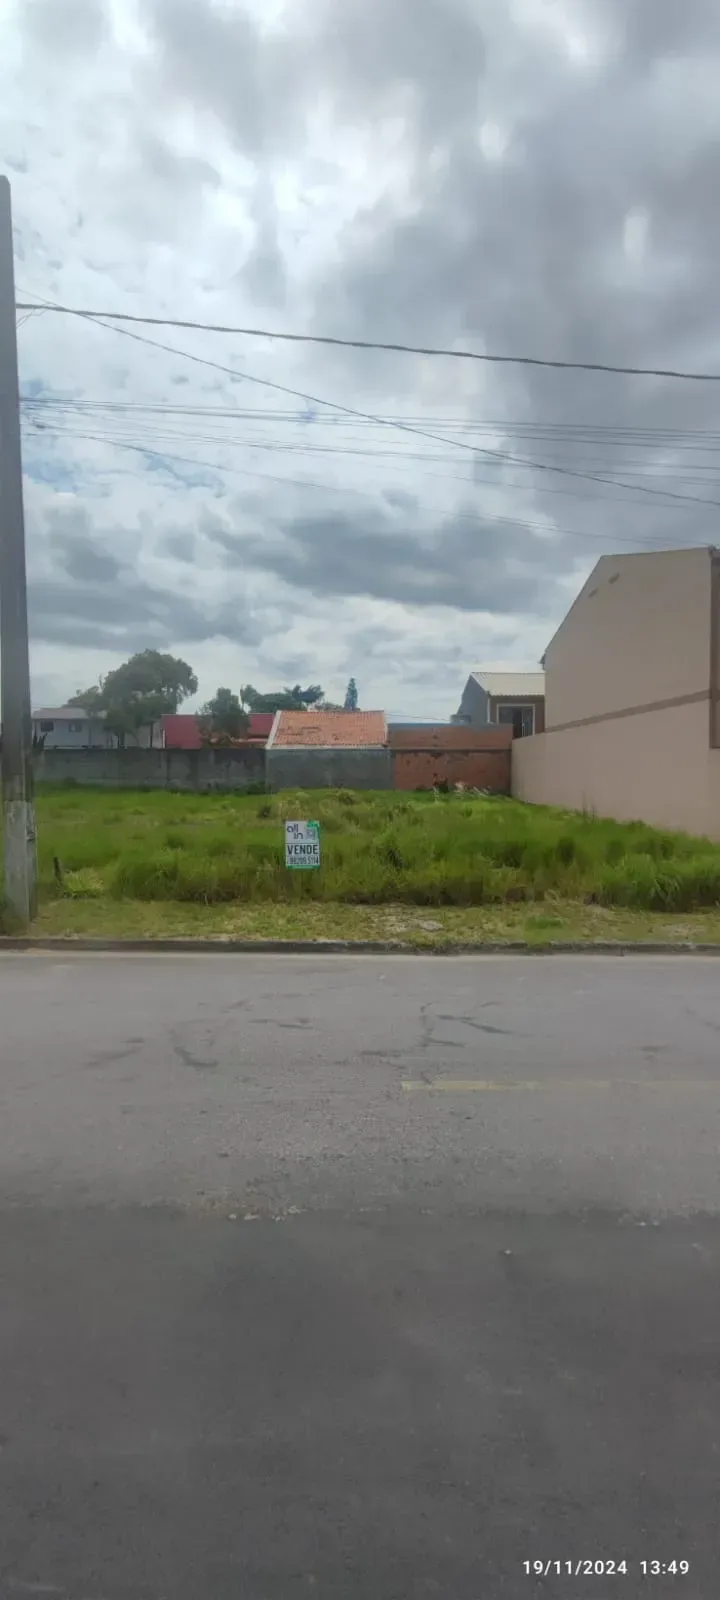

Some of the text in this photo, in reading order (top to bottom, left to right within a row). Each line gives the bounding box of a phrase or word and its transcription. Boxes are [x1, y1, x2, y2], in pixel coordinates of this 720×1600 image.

[287, 823, 299, 833] all
[293, 832, 304, 840] in
[288, 844, 319, 855] VENDE
